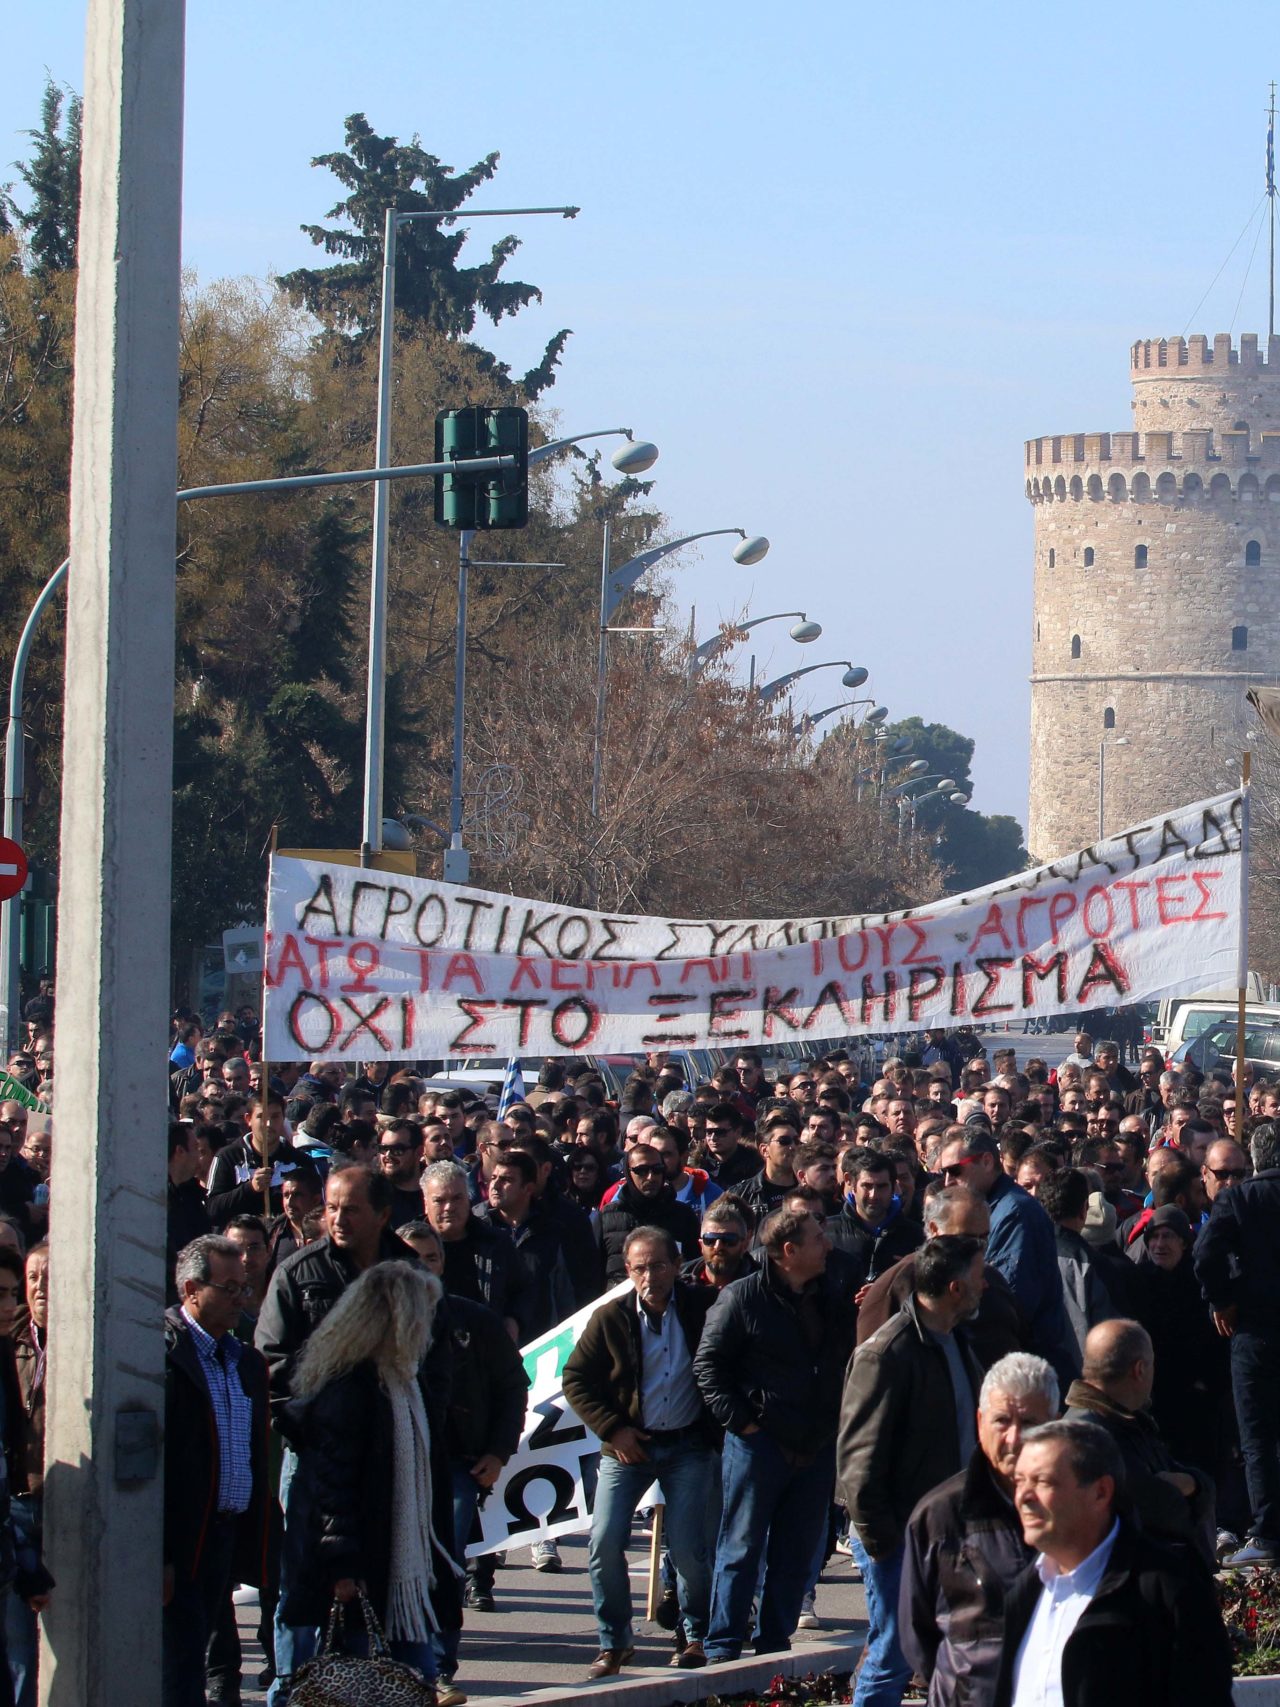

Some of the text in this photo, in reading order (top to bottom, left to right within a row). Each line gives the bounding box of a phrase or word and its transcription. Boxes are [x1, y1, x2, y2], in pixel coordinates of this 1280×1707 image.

[299, 873, 640, 962] ΑΓΡΟΤΙΚΟΣ
[967, 871, 1229, 953] ΑΓΡΟΤΕΣ
[288, 942, 1132, 1054] ΟΧΙ ΣΤΟ ΞΕΚΛΗΡΙΣΜΑ
